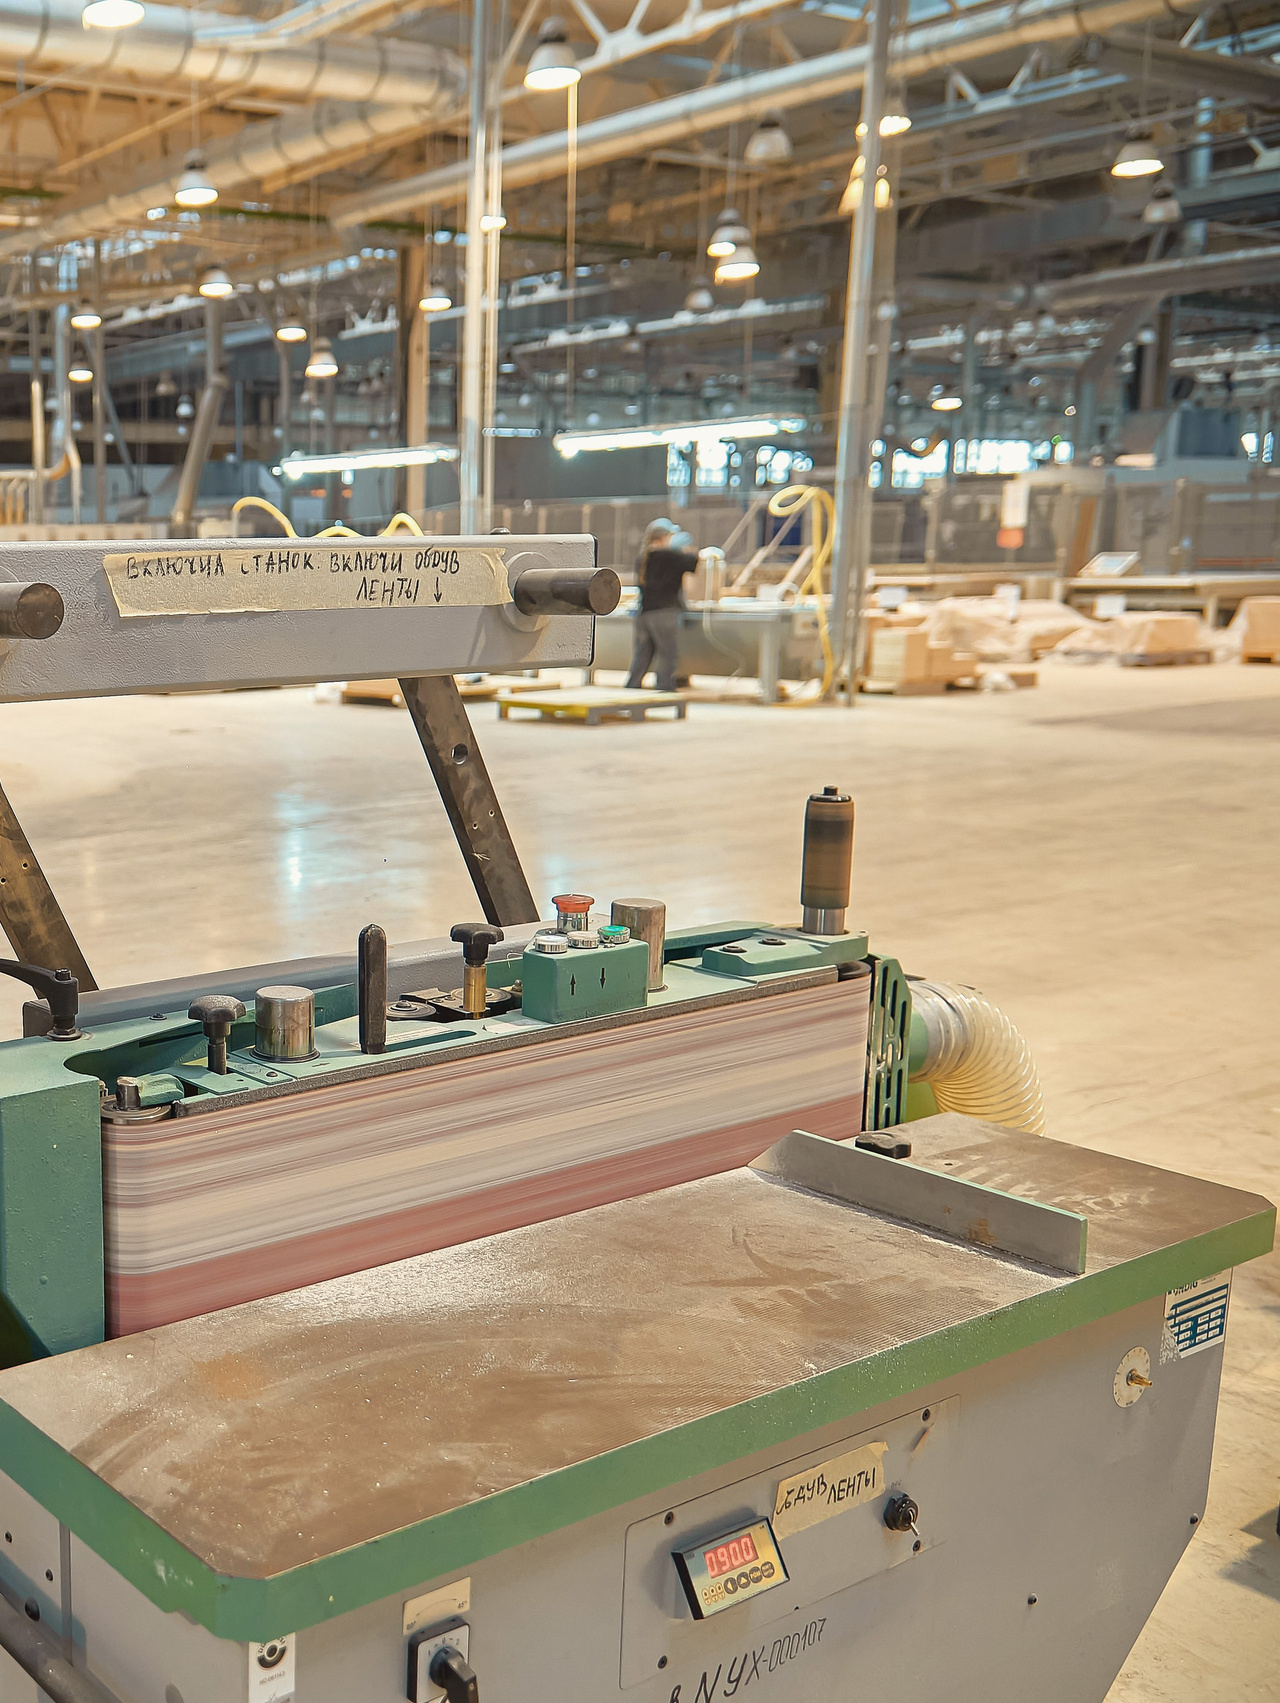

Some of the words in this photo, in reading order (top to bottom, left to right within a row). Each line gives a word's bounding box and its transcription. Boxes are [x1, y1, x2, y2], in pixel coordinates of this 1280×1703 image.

[329, 551, 402, 573] ВКЛЮЧИ
[356, 576, 420, 606] ЛЕНТЫ
[827, 1467, 876, 1505] ЛЕНТЫ
